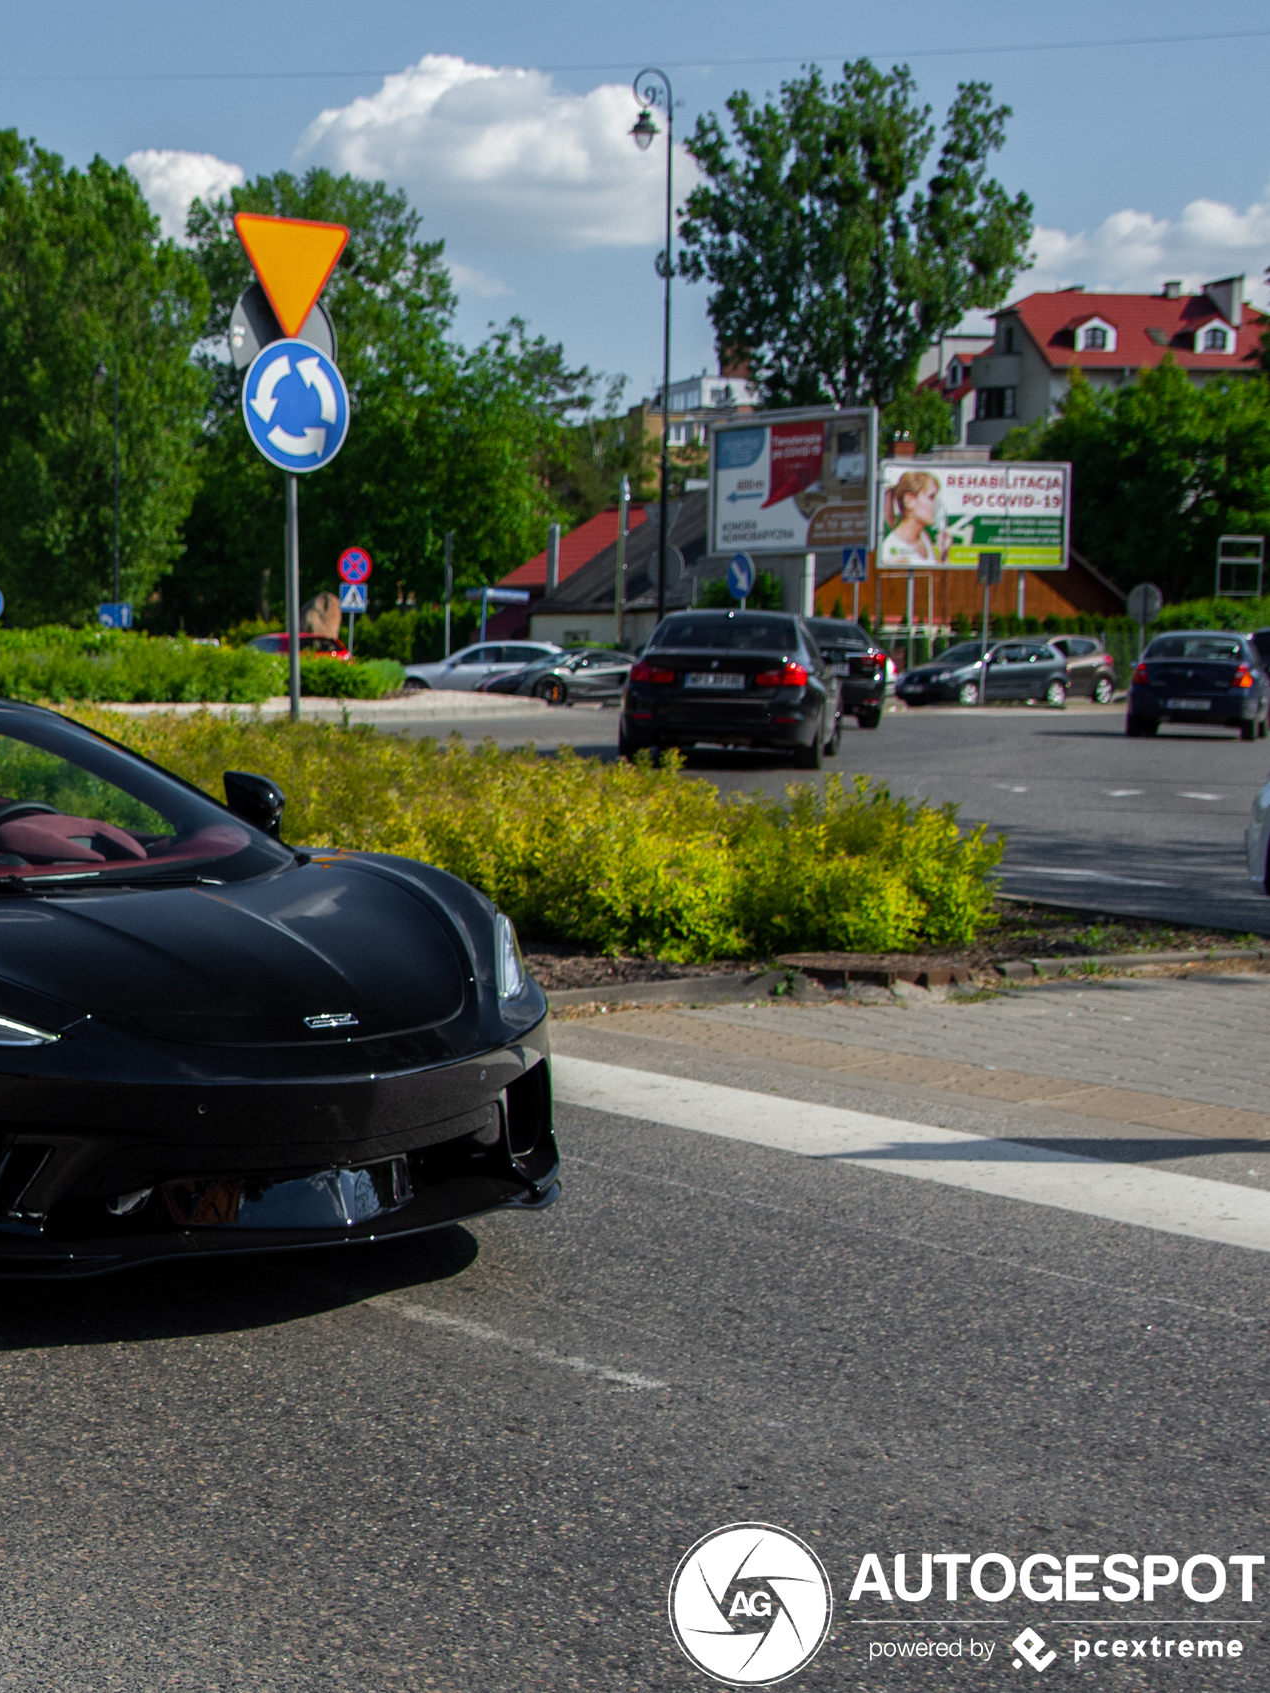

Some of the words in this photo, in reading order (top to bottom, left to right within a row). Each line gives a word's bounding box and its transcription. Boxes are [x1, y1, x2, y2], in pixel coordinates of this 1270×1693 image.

[946, 475, 1061, 491] REHABILITACJA
[962, 493, 983, 507] PO
[986, 493, 1061, 508] COVID-19
